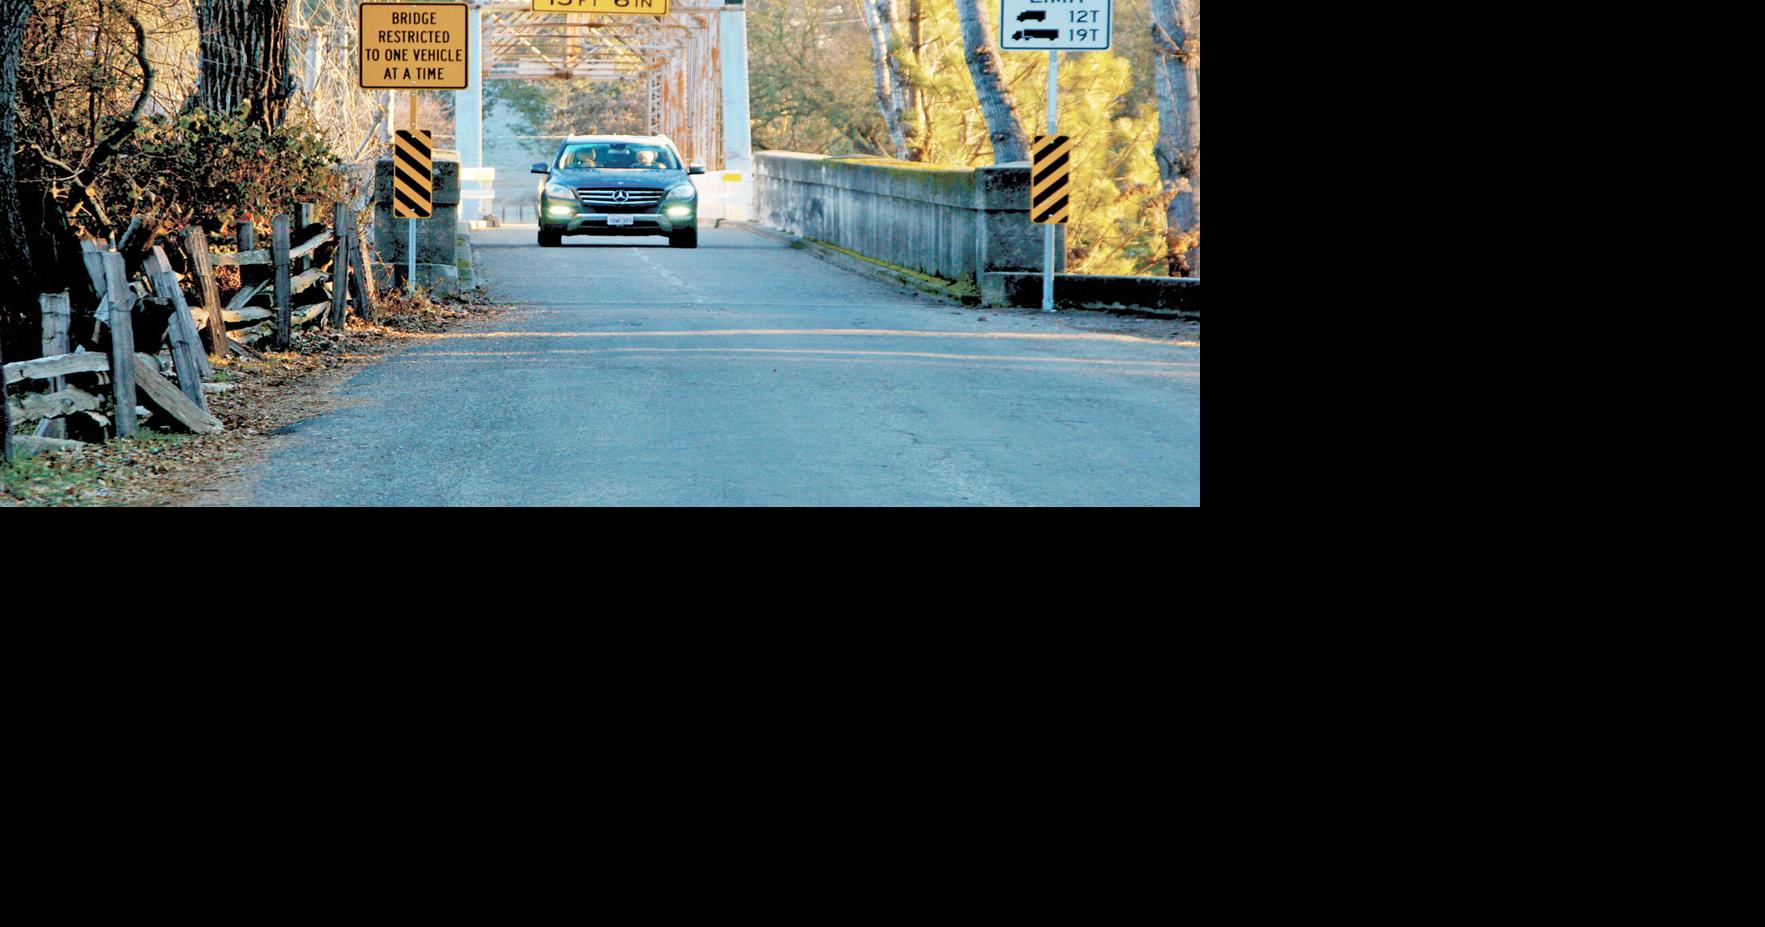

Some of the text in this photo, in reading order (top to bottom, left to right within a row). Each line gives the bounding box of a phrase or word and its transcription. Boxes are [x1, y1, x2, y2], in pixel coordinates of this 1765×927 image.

[392, 12, 437, 25] BRIDGE
[1069, 10, 1100, 23] 12T
[378, 30, 450, 43] RESTRICTED
[1069, 29, 1100, 41] 19T
[365, 48, 462, 61] TO ONE VEHICLE
[383, 67, 444, 80] AT A TIME
